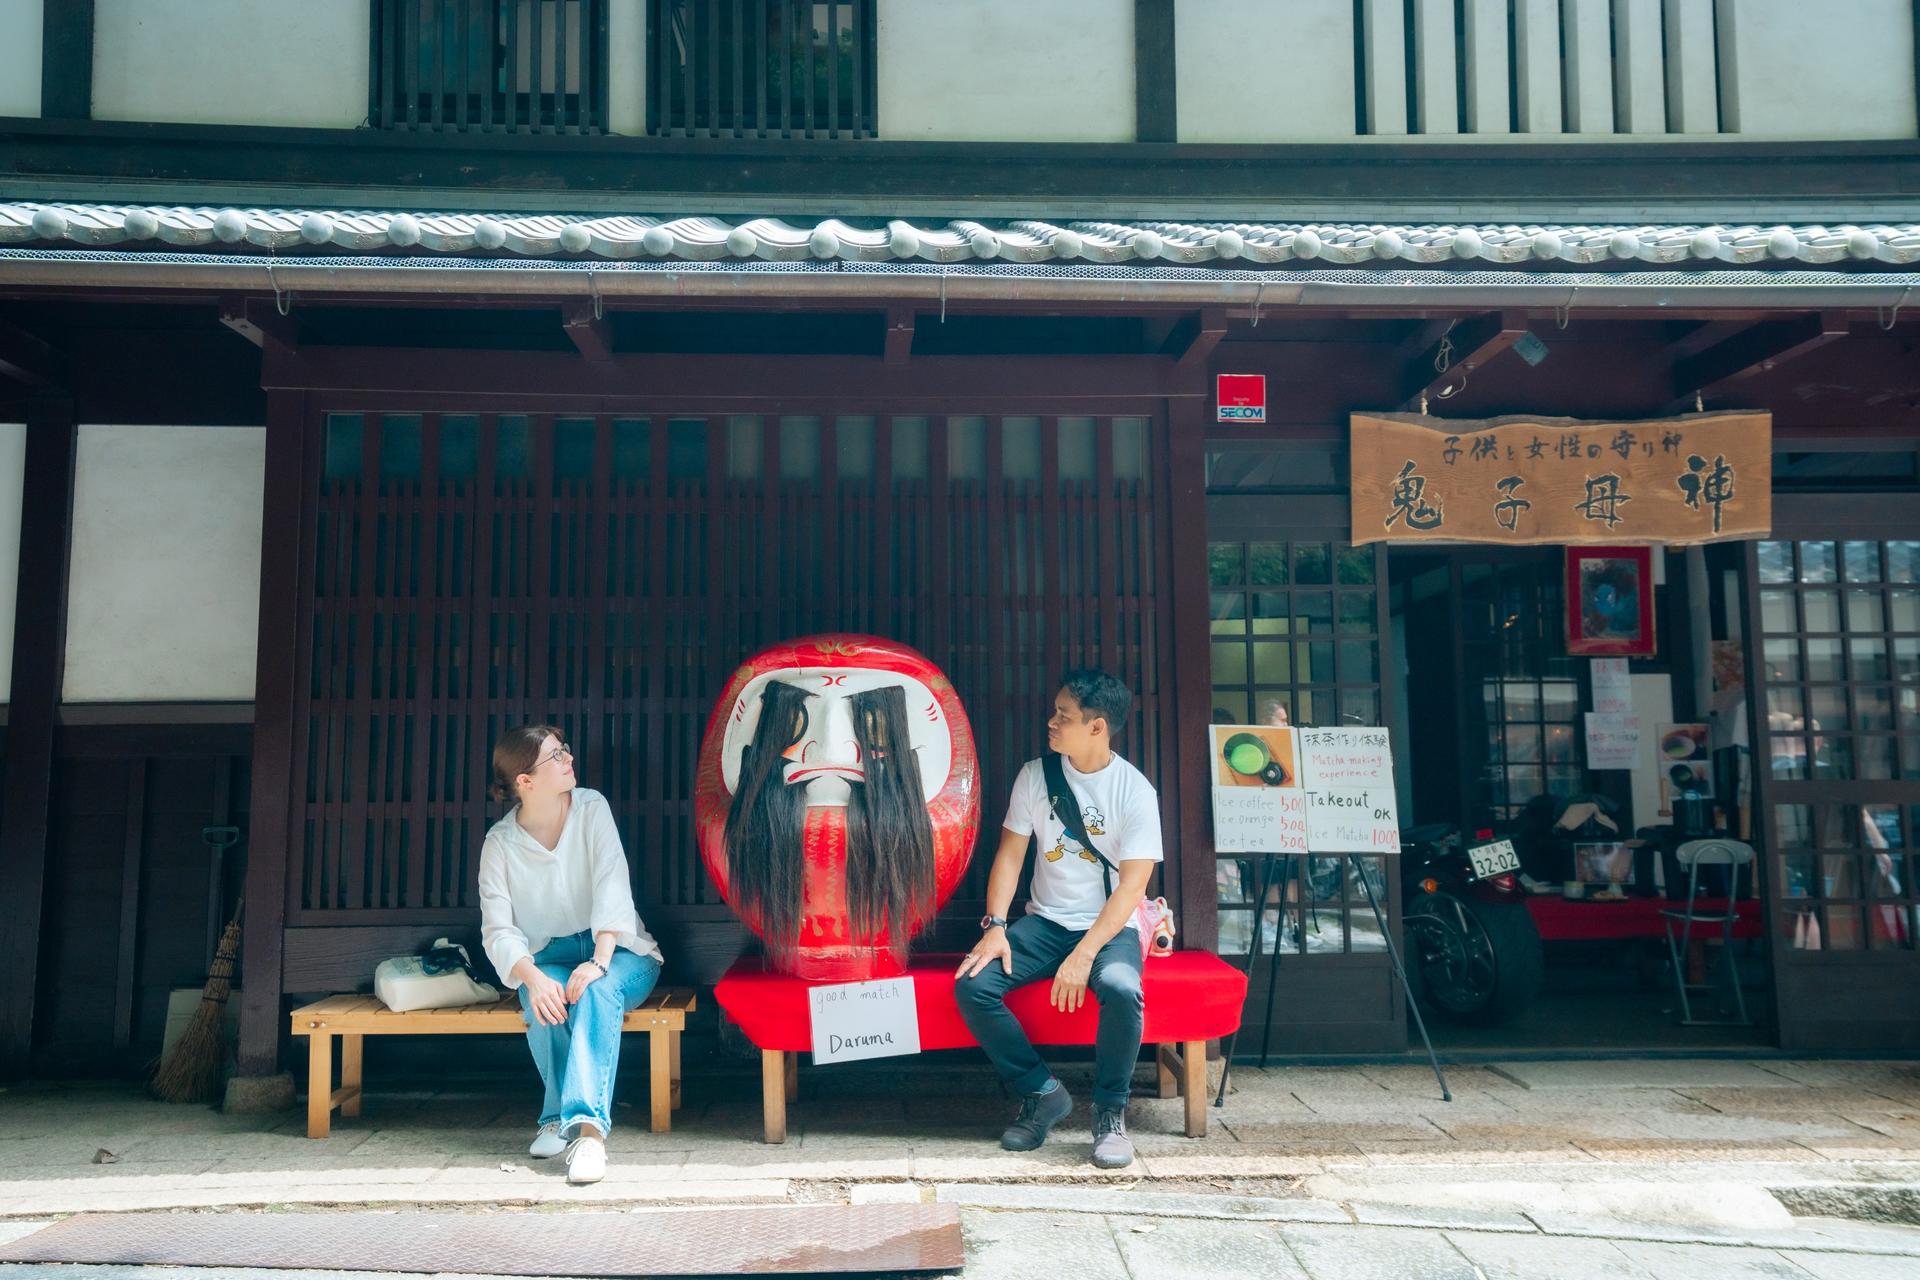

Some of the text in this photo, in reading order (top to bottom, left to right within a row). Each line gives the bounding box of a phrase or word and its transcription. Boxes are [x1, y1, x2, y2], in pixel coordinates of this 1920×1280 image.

[1220, 407, 1263, 418] SECOM
[1384, 455, 1735, 534] 鬼子母神
[1312, 754, 1382, 767] Matcha making
[1319, 769, 1378, 781] experience
[1239, 794, 1274, 810] coffee
[1306, 791, 1369, 808] Takeout
[1217, 814, 1234, 824] Ice
[1218, 832, 1236, 847] Ice
[1240, 832, 1265, 848] tea
[1309, 825, 1328, 840] Ice
[1336, 826, 1368, 841] Matcha
[860, 982, 900, 1000] match
[829, 1032, 894, 1054] Daruma
